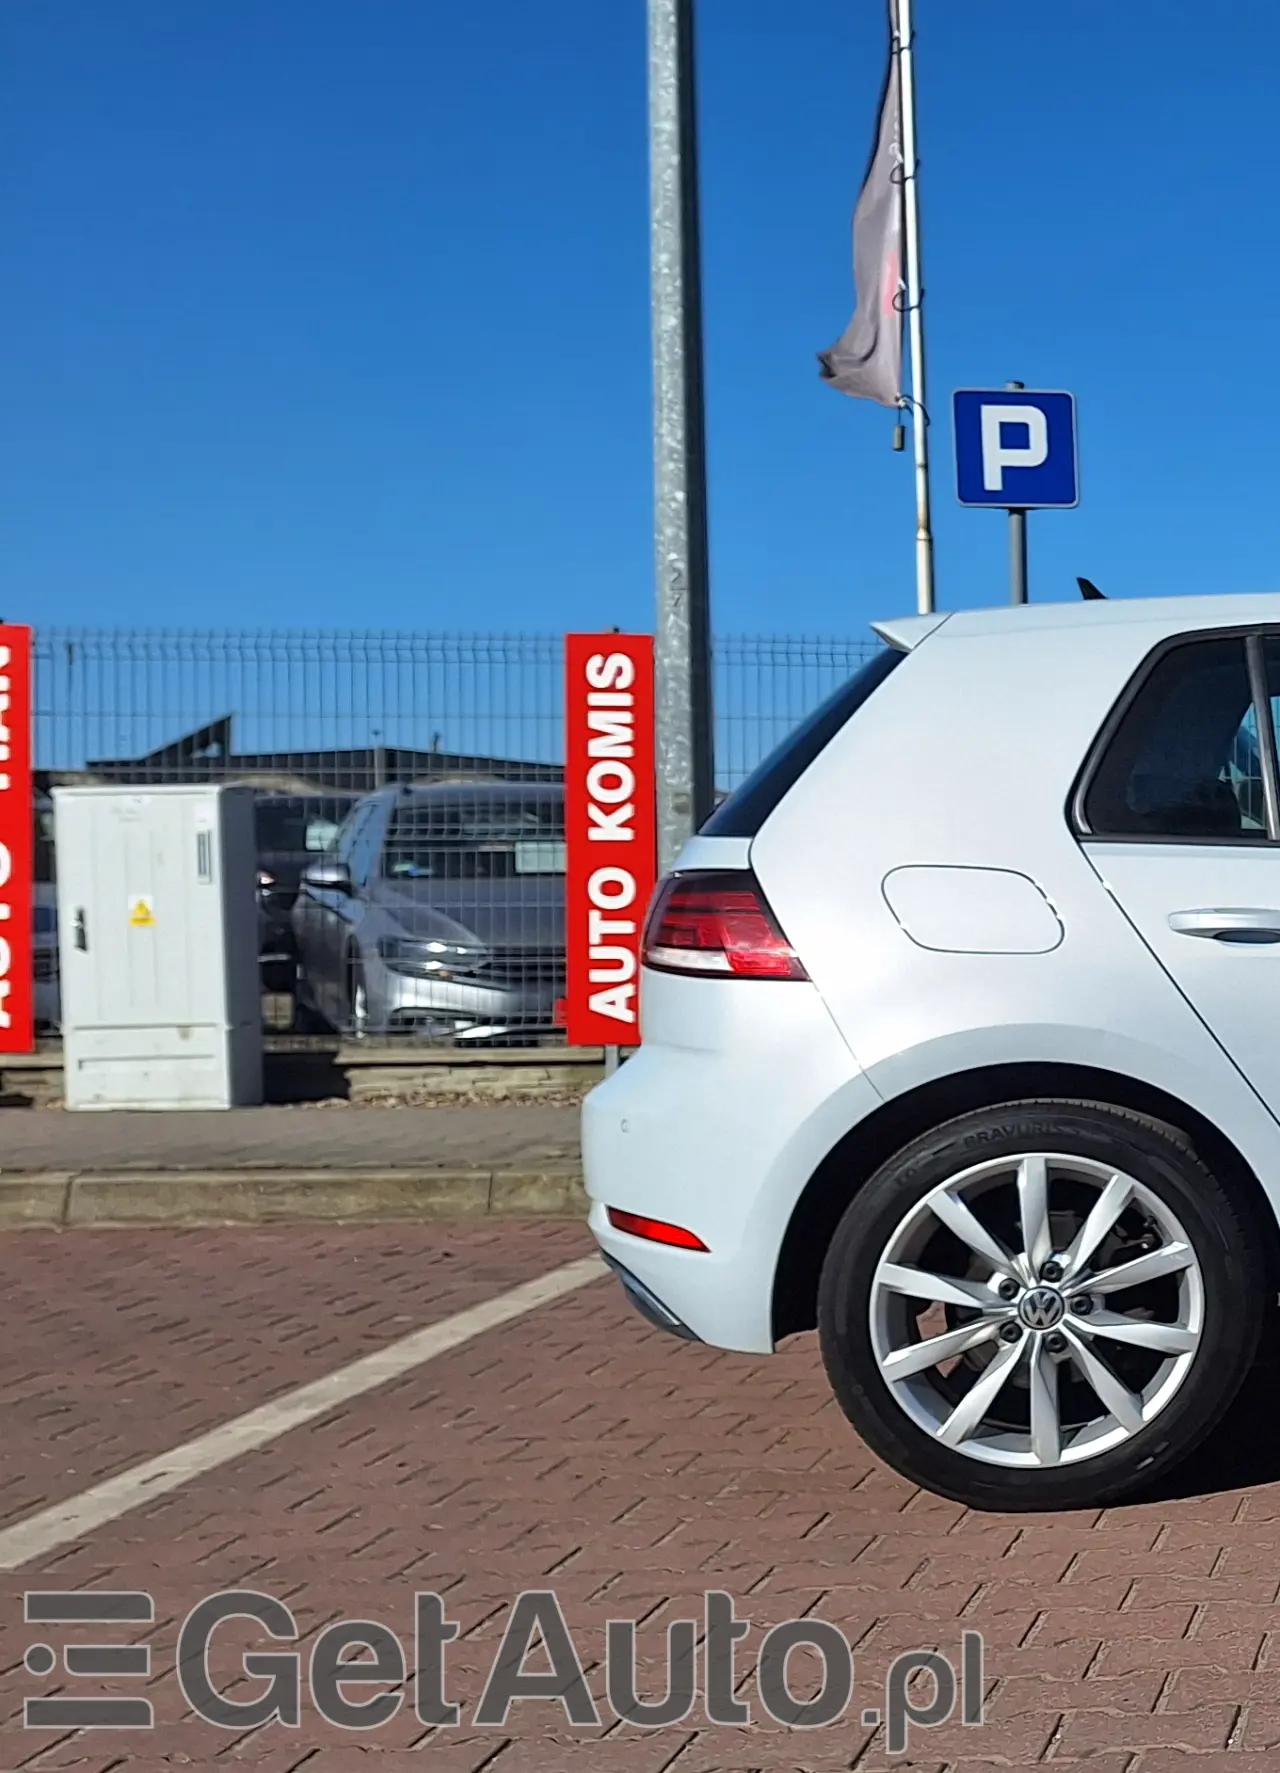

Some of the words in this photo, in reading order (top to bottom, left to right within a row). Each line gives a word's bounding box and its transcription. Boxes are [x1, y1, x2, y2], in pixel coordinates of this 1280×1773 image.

[981, 405, 1048, 491] P
[586, 652, 636, 841] KOMIS
[586, 866, 637, 1024] AUTO
